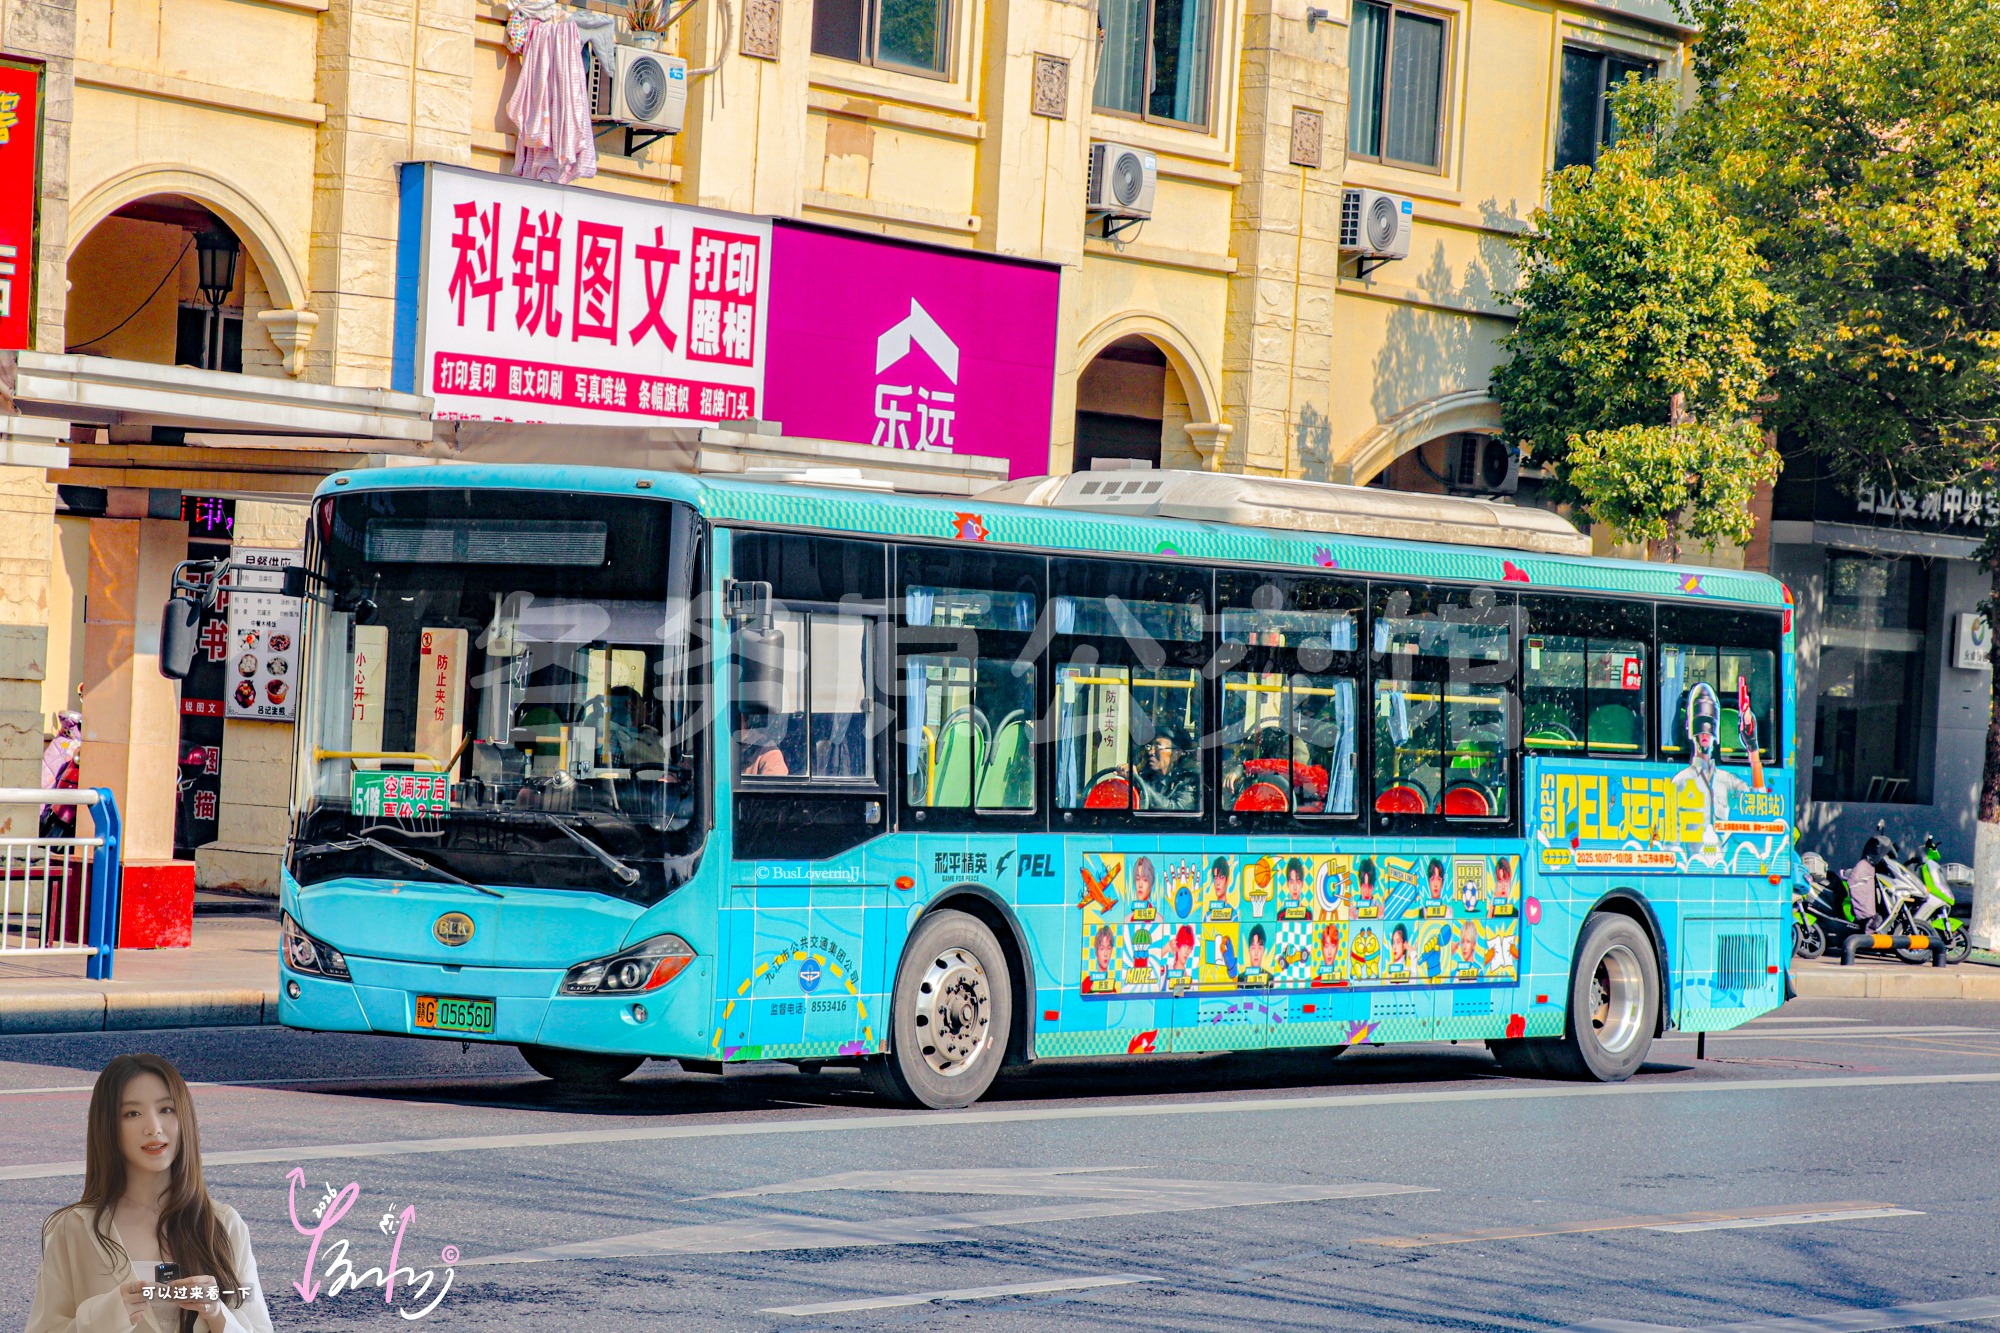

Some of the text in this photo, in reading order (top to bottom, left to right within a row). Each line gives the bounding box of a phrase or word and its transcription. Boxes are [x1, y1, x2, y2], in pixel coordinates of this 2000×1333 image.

[448, 200, 681, 354] 科锐图文
[694, 236, 756, 297] 打印
[690, 298, 752, 360] 照相
[440, 357, 749, 419] 打印复印 图文印刷 写真喷绘 条幅旗帜 招牌门头
[871, 384, 955, 454] 乐远
[351, 651, 367, 721] 小心开门
[433, 654, 448, 722] 防止夹伤
[1103, 690, 1117, 748] 防止夹伤
[383, 774, 447, 800] 空调开启
[934, 852, 987, 874] 和平精英
[1017, 854, 1056, 877] PEL
[765, 934, 859, 985] 九江市公共交通集团公司
[811, 1000, 847, 1012] 8553416
